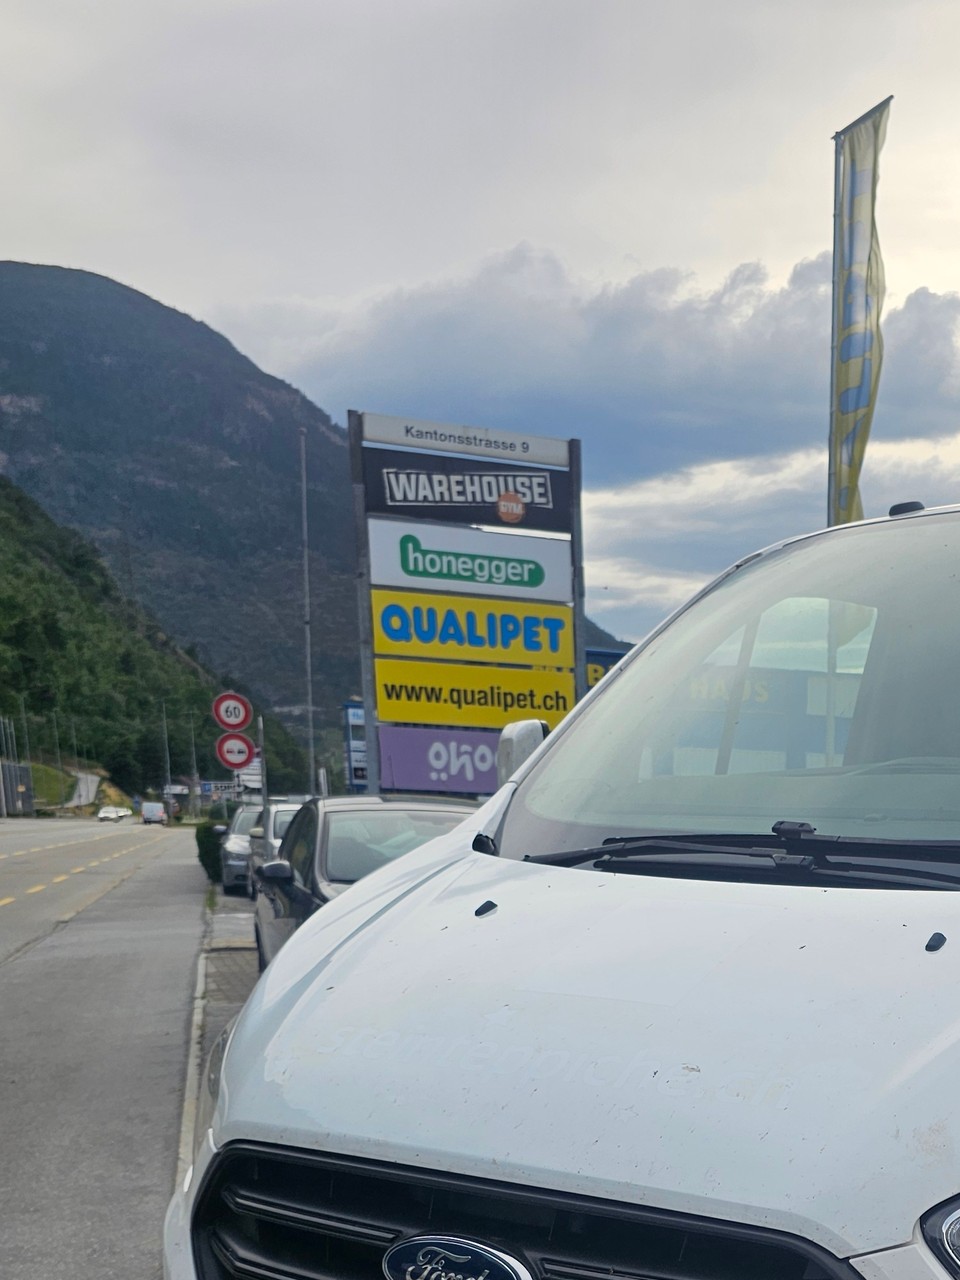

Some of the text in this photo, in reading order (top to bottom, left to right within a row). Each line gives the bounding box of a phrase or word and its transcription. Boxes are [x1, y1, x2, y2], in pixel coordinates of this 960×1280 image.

[404, 425, 530, 453] Kantonsstrasse 9
[387, 473, 548, 504] WAREHOUSE
[499, 501, 523, 514] GYM
[406, 542, 535, 583] honegger
[380, 603, 565, 653] QUALIPET
[384, 682, 568, 712] www.qualipet.ch
[225, 706, 241, 719] 60
